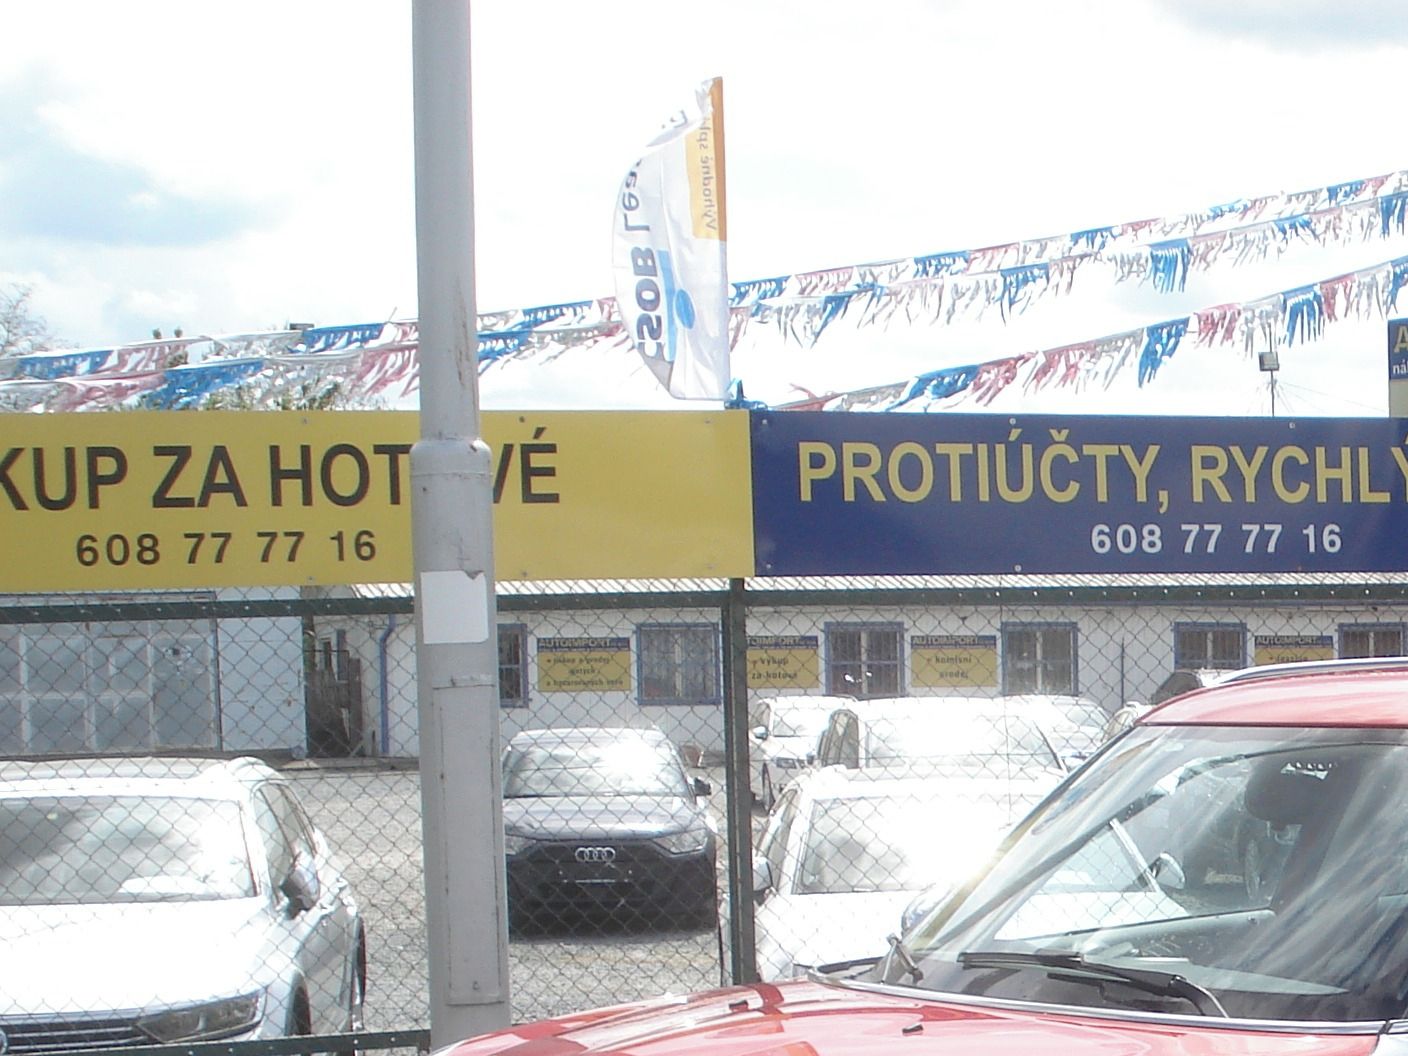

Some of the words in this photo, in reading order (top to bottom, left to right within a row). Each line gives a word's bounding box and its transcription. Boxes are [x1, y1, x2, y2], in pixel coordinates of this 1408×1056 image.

[0, 445, 129, 511] KUP
[151, 444, 249, 508] ZA
[269, 426, 560, 508] HOTVÉ
[798, 429, 1170, 514] PROTIÚČTY,
[76, 532, 162, 567] 608
[184, 531, 232, 564] 77
[256, 530, 306, 563] 77
[328, 529, 377, 562] 16
[1090, 523, 1164, 555] 608
[1180, 523, 1222, 554] 77
[1241, 523, 1283, 553] 77
[1302, 523, 1342, 553] 16
